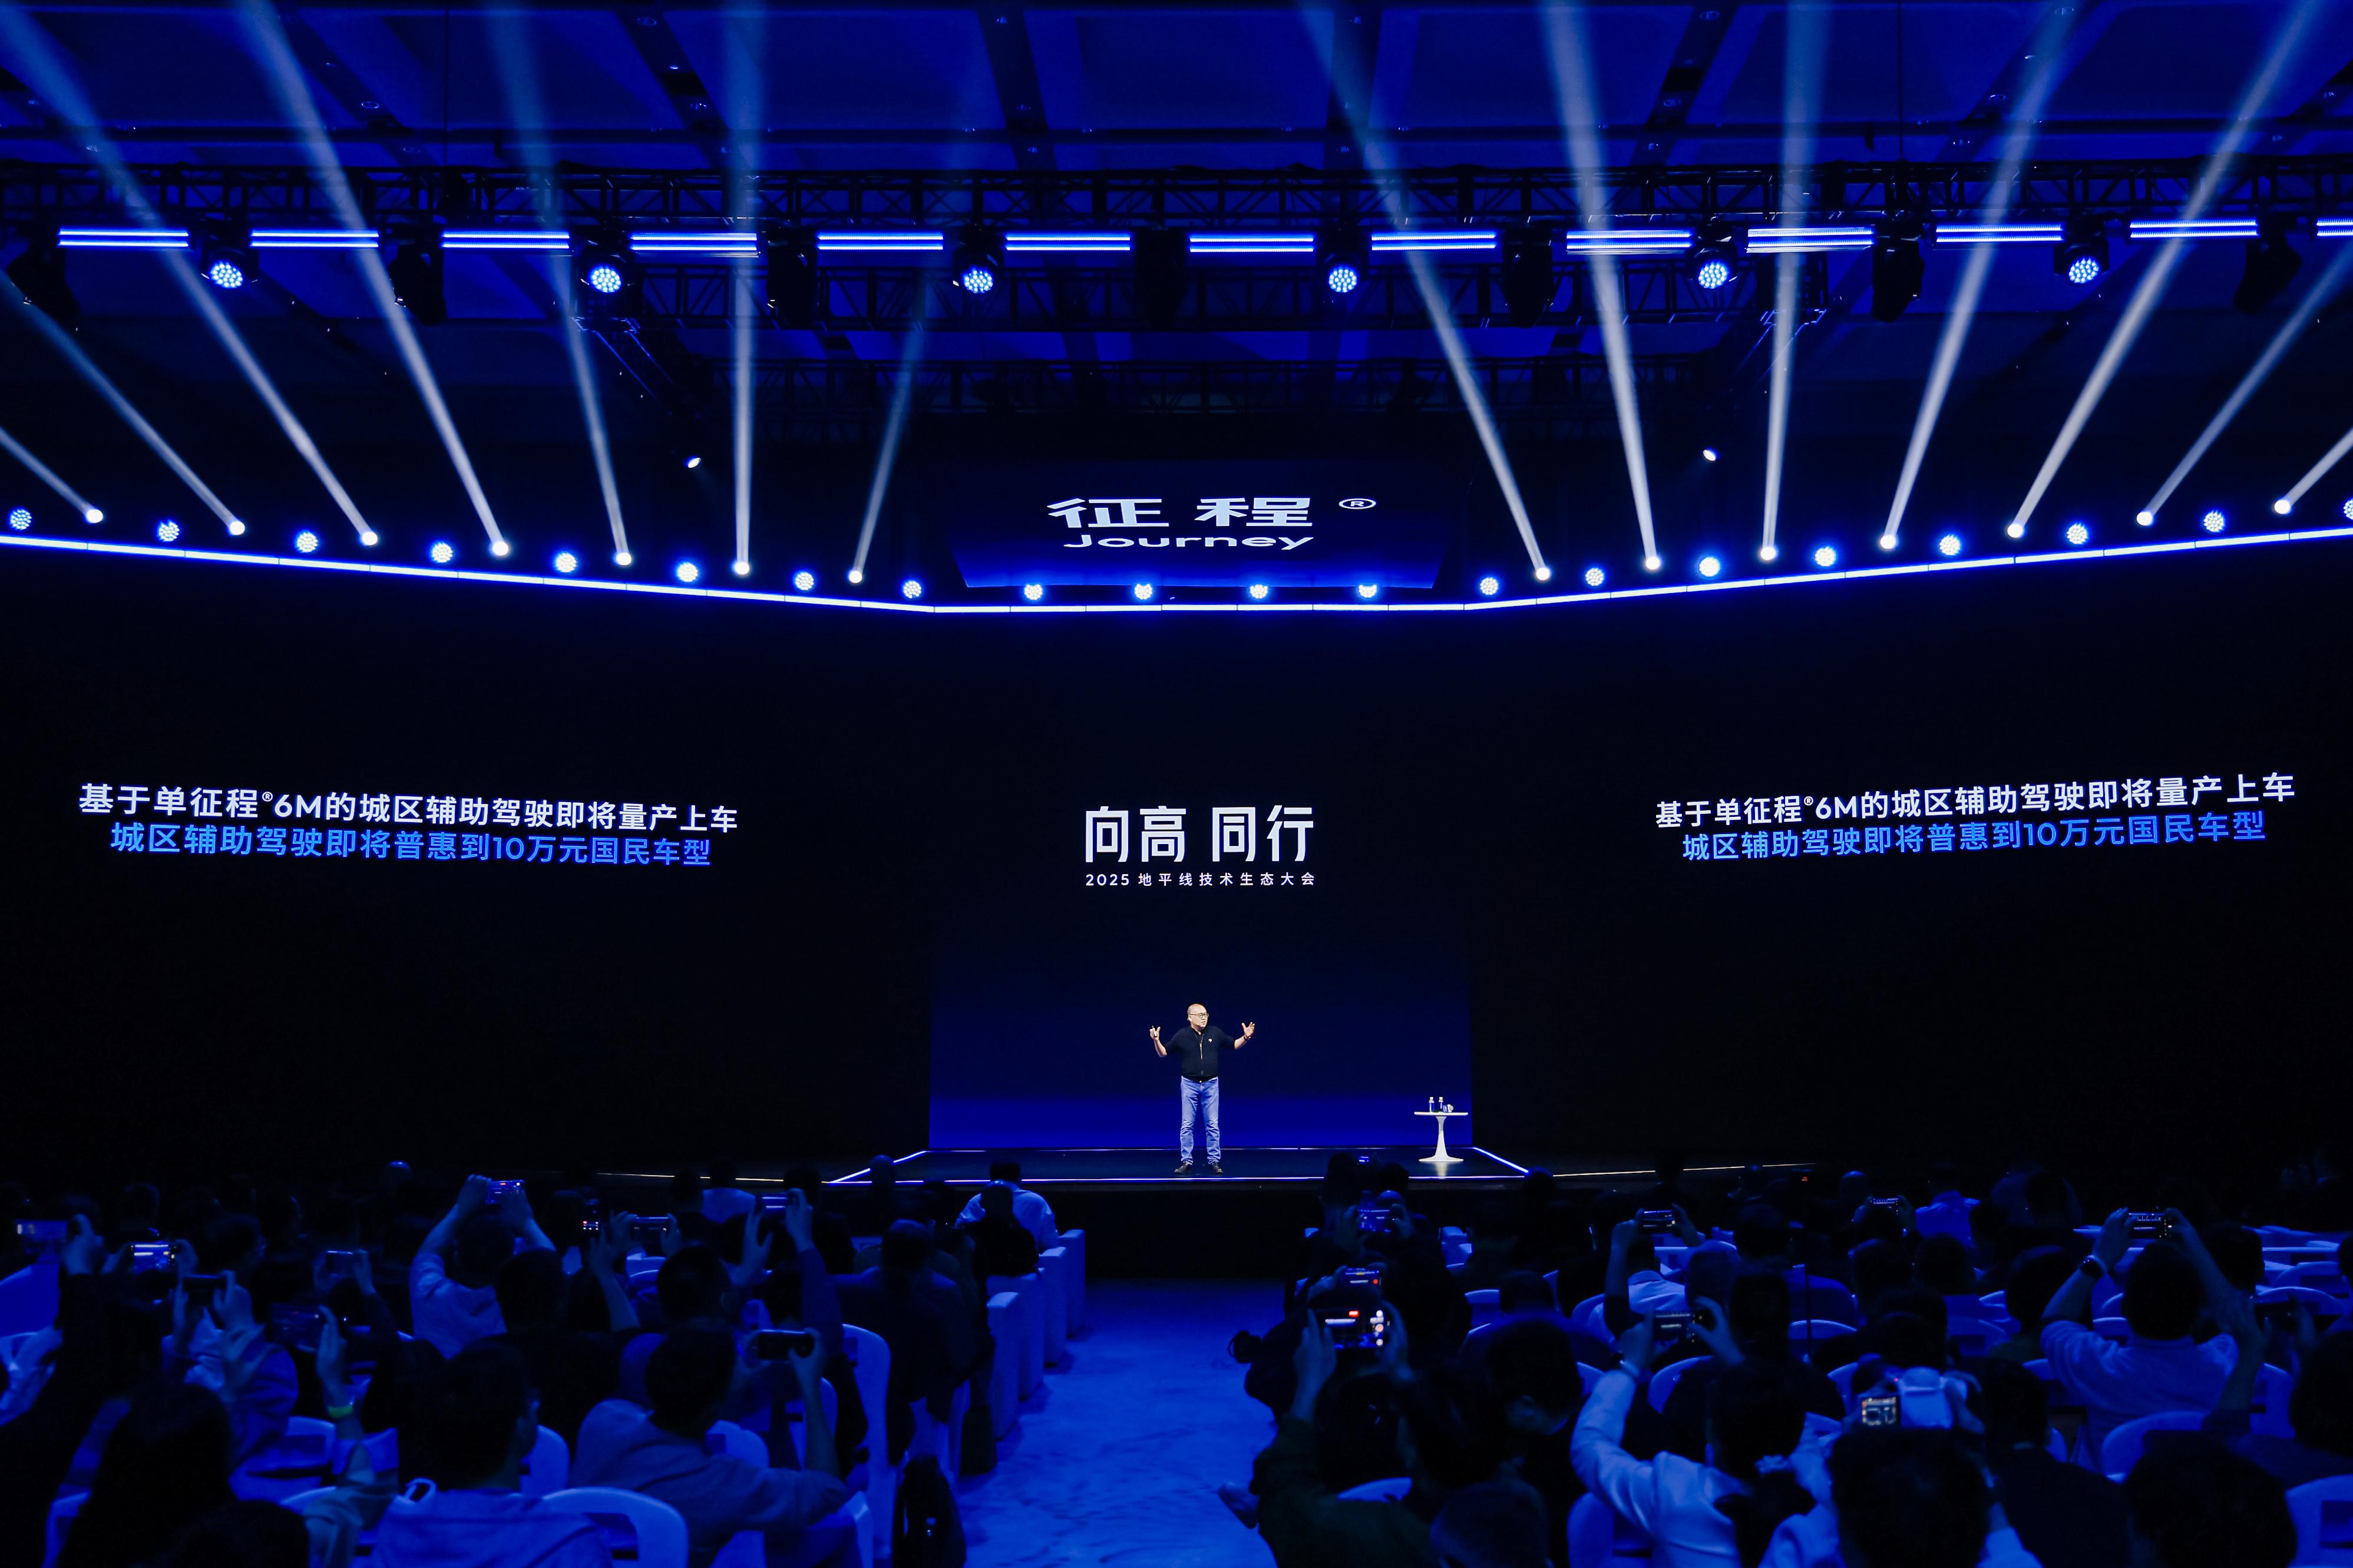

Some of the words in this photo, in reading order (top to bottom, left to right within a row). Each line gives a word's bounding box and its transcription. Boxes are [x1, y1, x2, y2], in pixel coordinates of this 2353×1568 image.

[1047, 497, 1313, 528] 征程
[1063, 534, 1314, 550] Journey
[110, 821, 711, 866] 城区辅助驾驶即将普惠到10万元国民车型
[1086, 805, 1187, 862] 向高
[1212, 805, 1314, 862] 同行
[1683, 810, 2266, 860] 城区辅助驾驶即将普惠到10万元国民车型
[1086, 874, 1129, 886] 2025
[1138, 872, 1314, 886] 地平线技术生态大会
